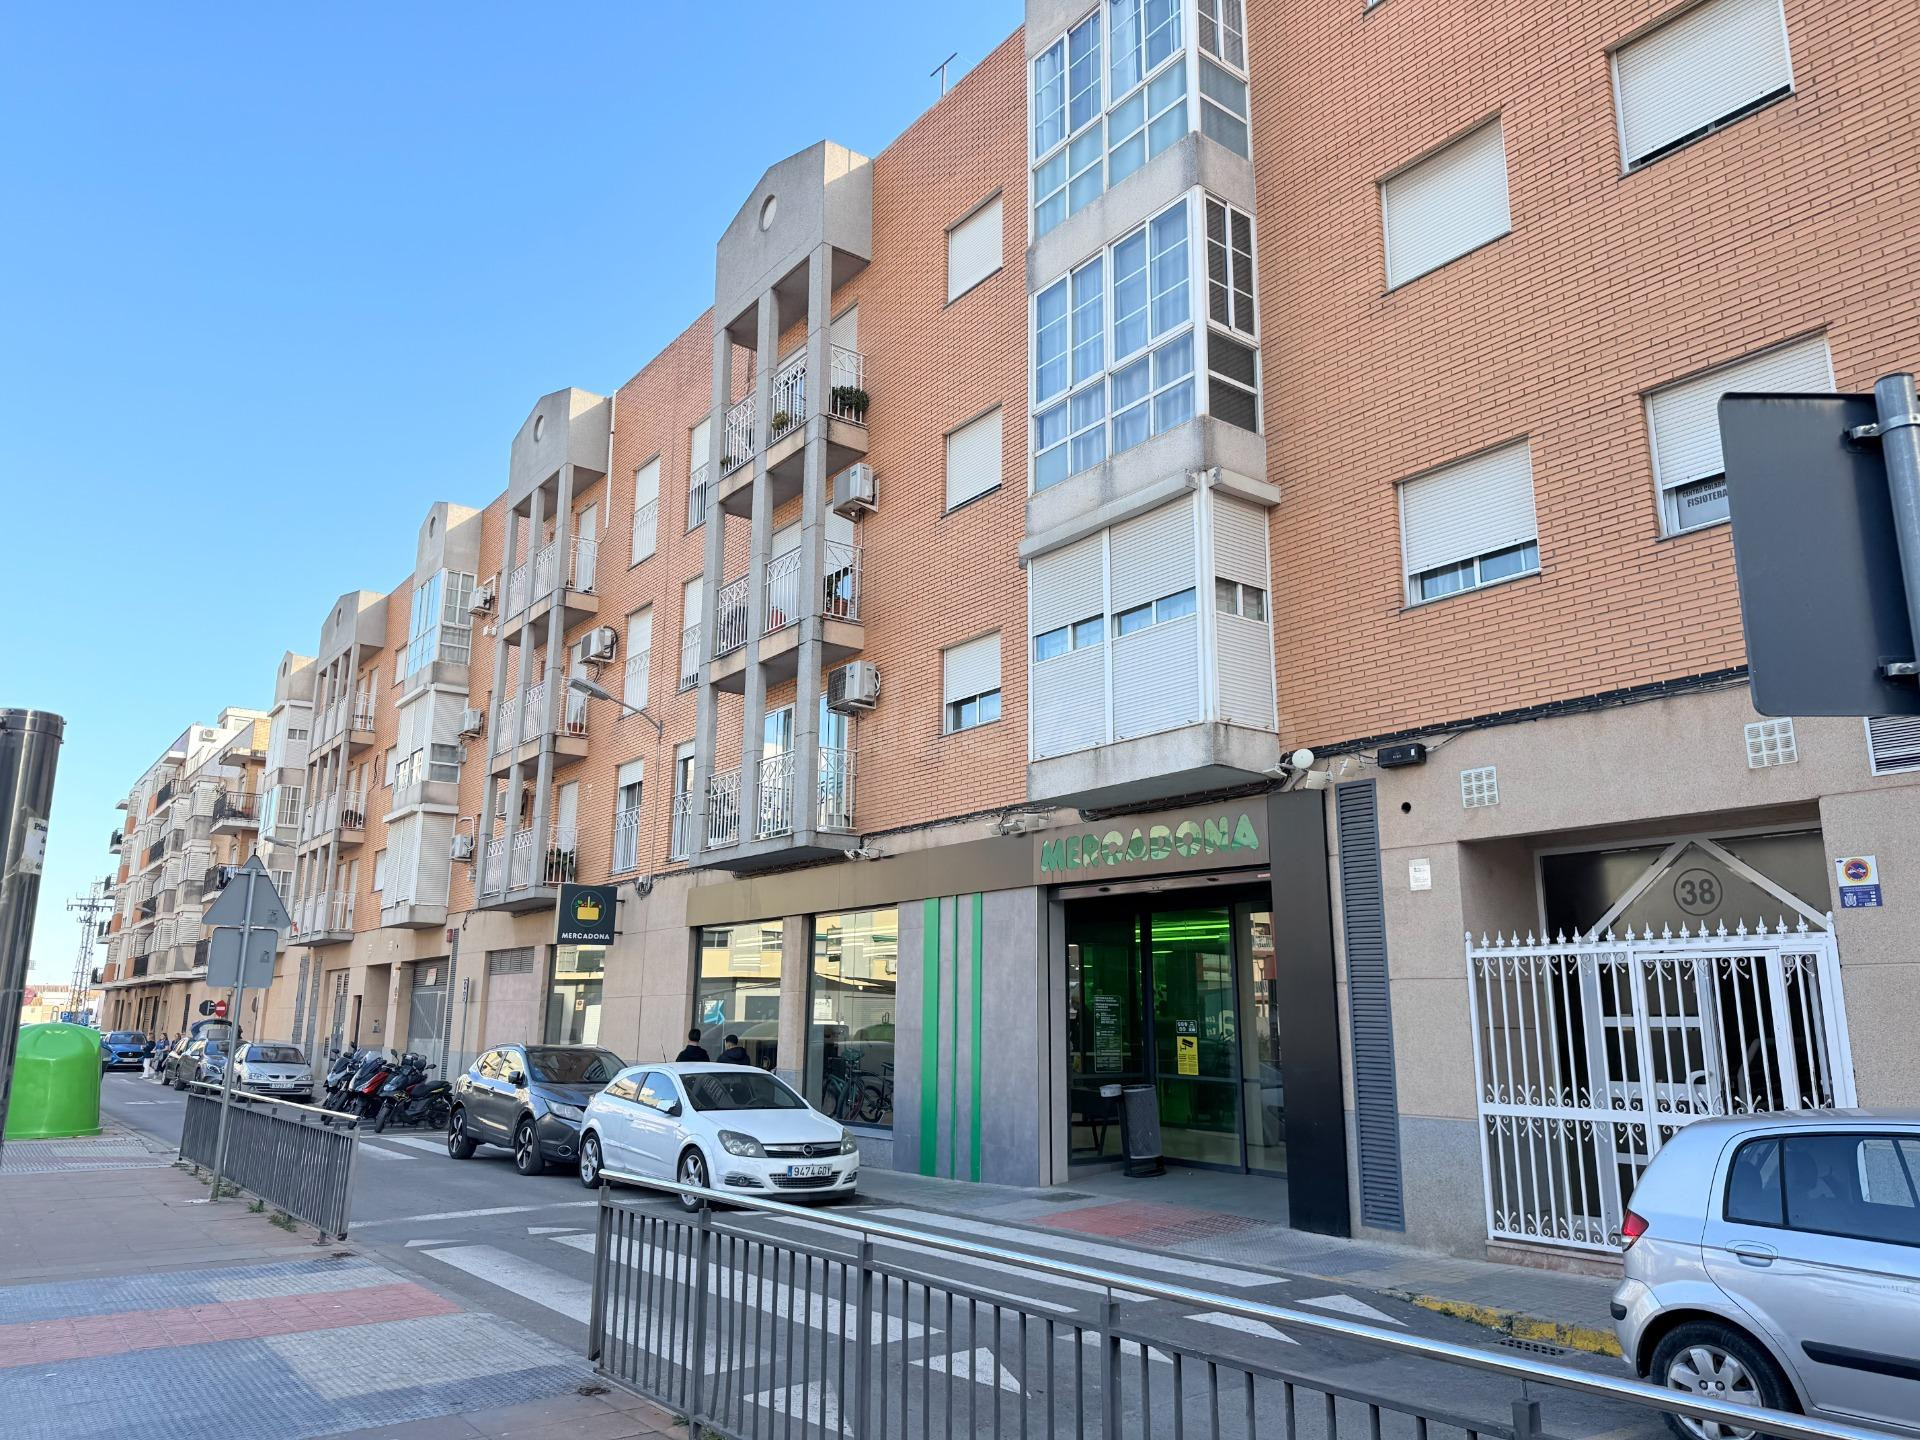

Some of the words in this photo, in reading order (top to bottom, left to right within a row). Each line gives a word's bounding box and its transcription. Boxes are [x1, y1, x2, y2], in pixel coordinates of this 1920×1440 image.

[1687, 489, 1728, 507] FISIOTERA
[1040, 814, 1259, 872] MERCADONA
[1681, 879, 1715, 905] 38
[561, 932, 610, 940] MERCADONA
[793, 1166, 815, 1176] 9474
